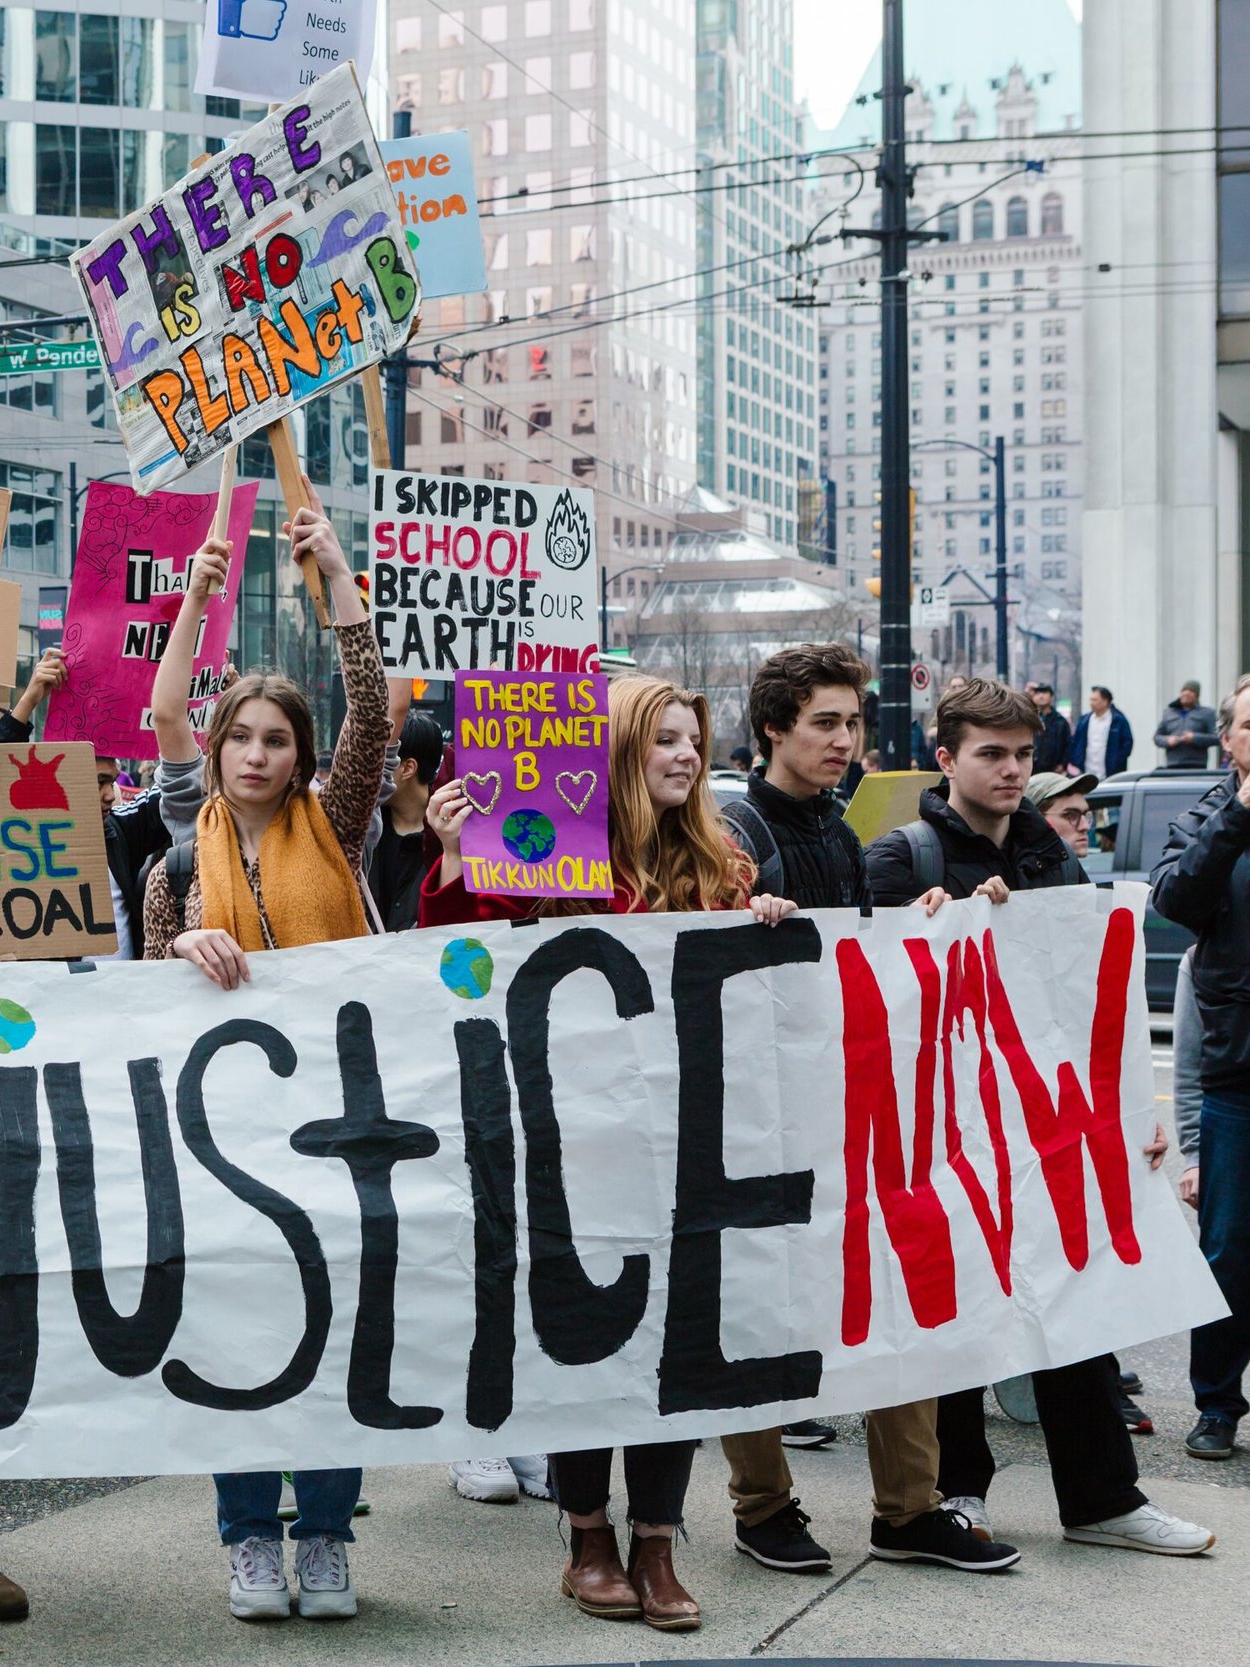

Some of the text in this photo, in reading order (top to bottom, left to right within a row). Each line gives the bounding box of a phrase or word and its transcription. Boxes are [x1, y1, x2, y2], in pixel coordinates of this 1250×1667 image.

[306, 12, 347, 34] Needs
[302, 41, 339, 61] Some
[299, 69, 320, 86] Lik
[388, 153, 450, 183] ave
[87, 104, 322, 300] THERE
[398, 193, 468, 226] tion
[161, 283, 200, 342] IS
[222, 232, 303, 312] NO
[365, 237, 416, 324] B
[10, 346, 99, 369] W Pende
[375, 475, 538, 527] I SKIPPED
[374, 521, 541, 579] SCHOOL
[374, 562, 583, 621] BECAUSE OUR
[125, 618, 206, 660] NET
[374, 611, 534, 671] EARTH IS
[517, 642, 600, 673] DYING
[463, 679, 596, 713] THERE IS
[461, 714, 609, 749] NO PLANET
[513, 751, 541, 791] B
[462, 855, 614, 892] TIKKUN OLAM
[837, 907, 1143, 1347] NOW
